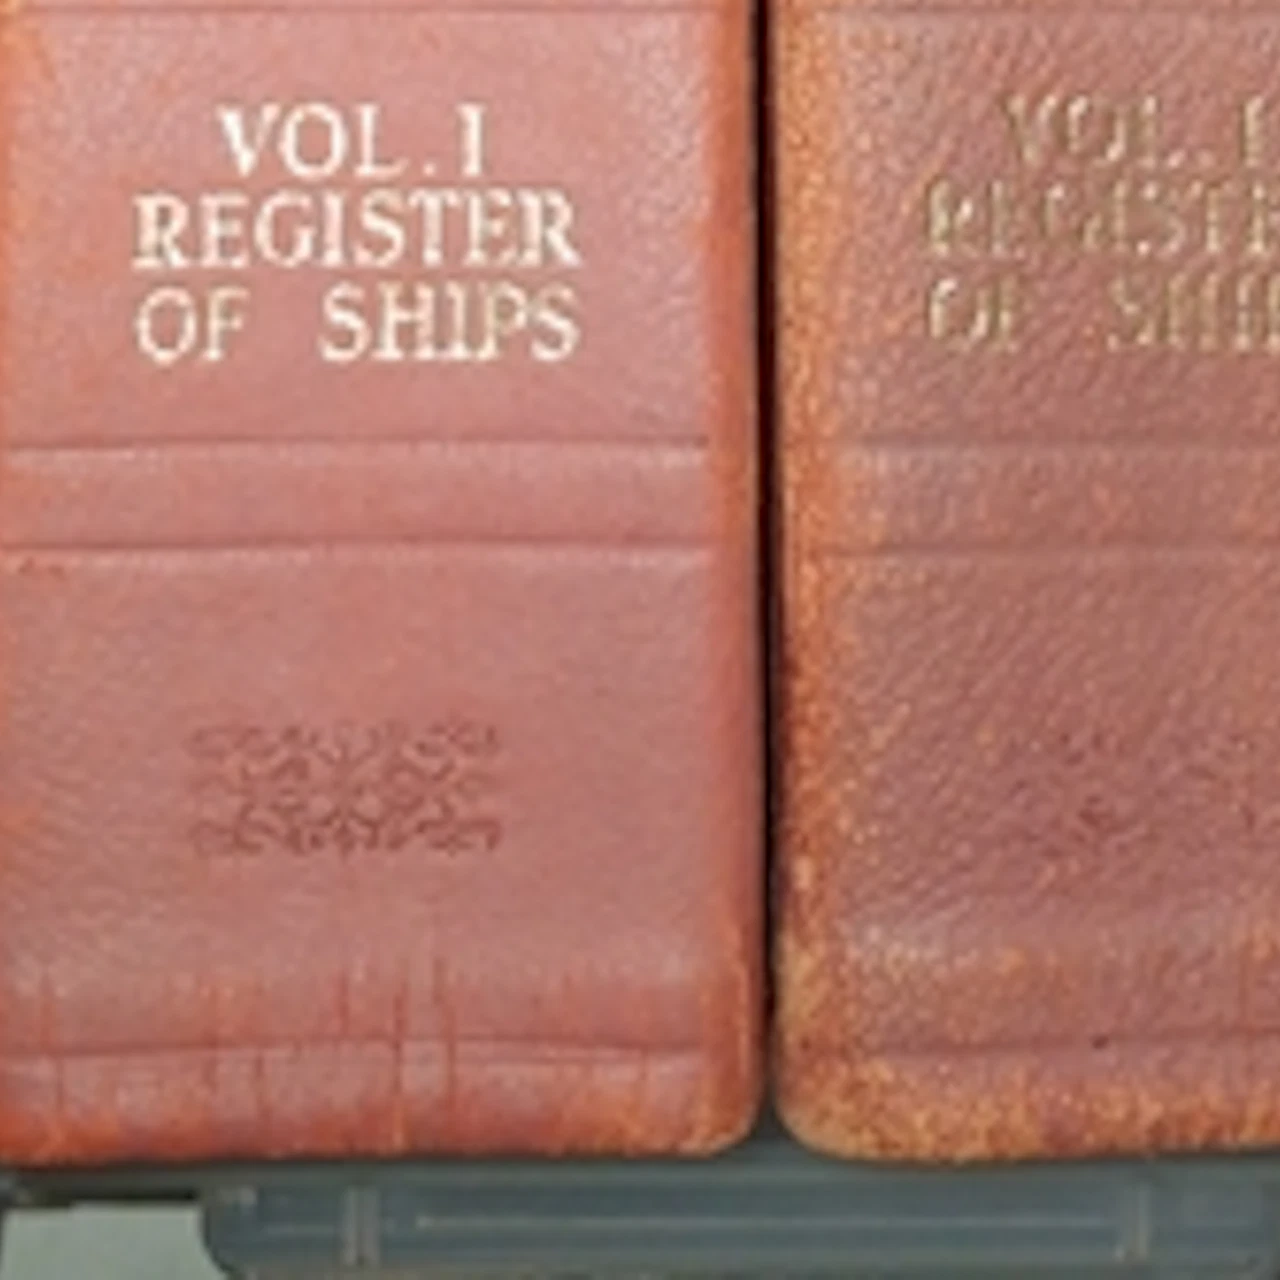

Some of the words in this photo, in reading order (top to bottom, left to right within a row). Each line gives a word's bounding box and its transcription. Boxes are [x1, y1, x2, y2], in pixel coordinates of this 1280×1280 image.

[131, 187, 583, 268] REGISTER
[134, 284, 251, 366] OF
[317, 279, 582, 364] SHIPS
